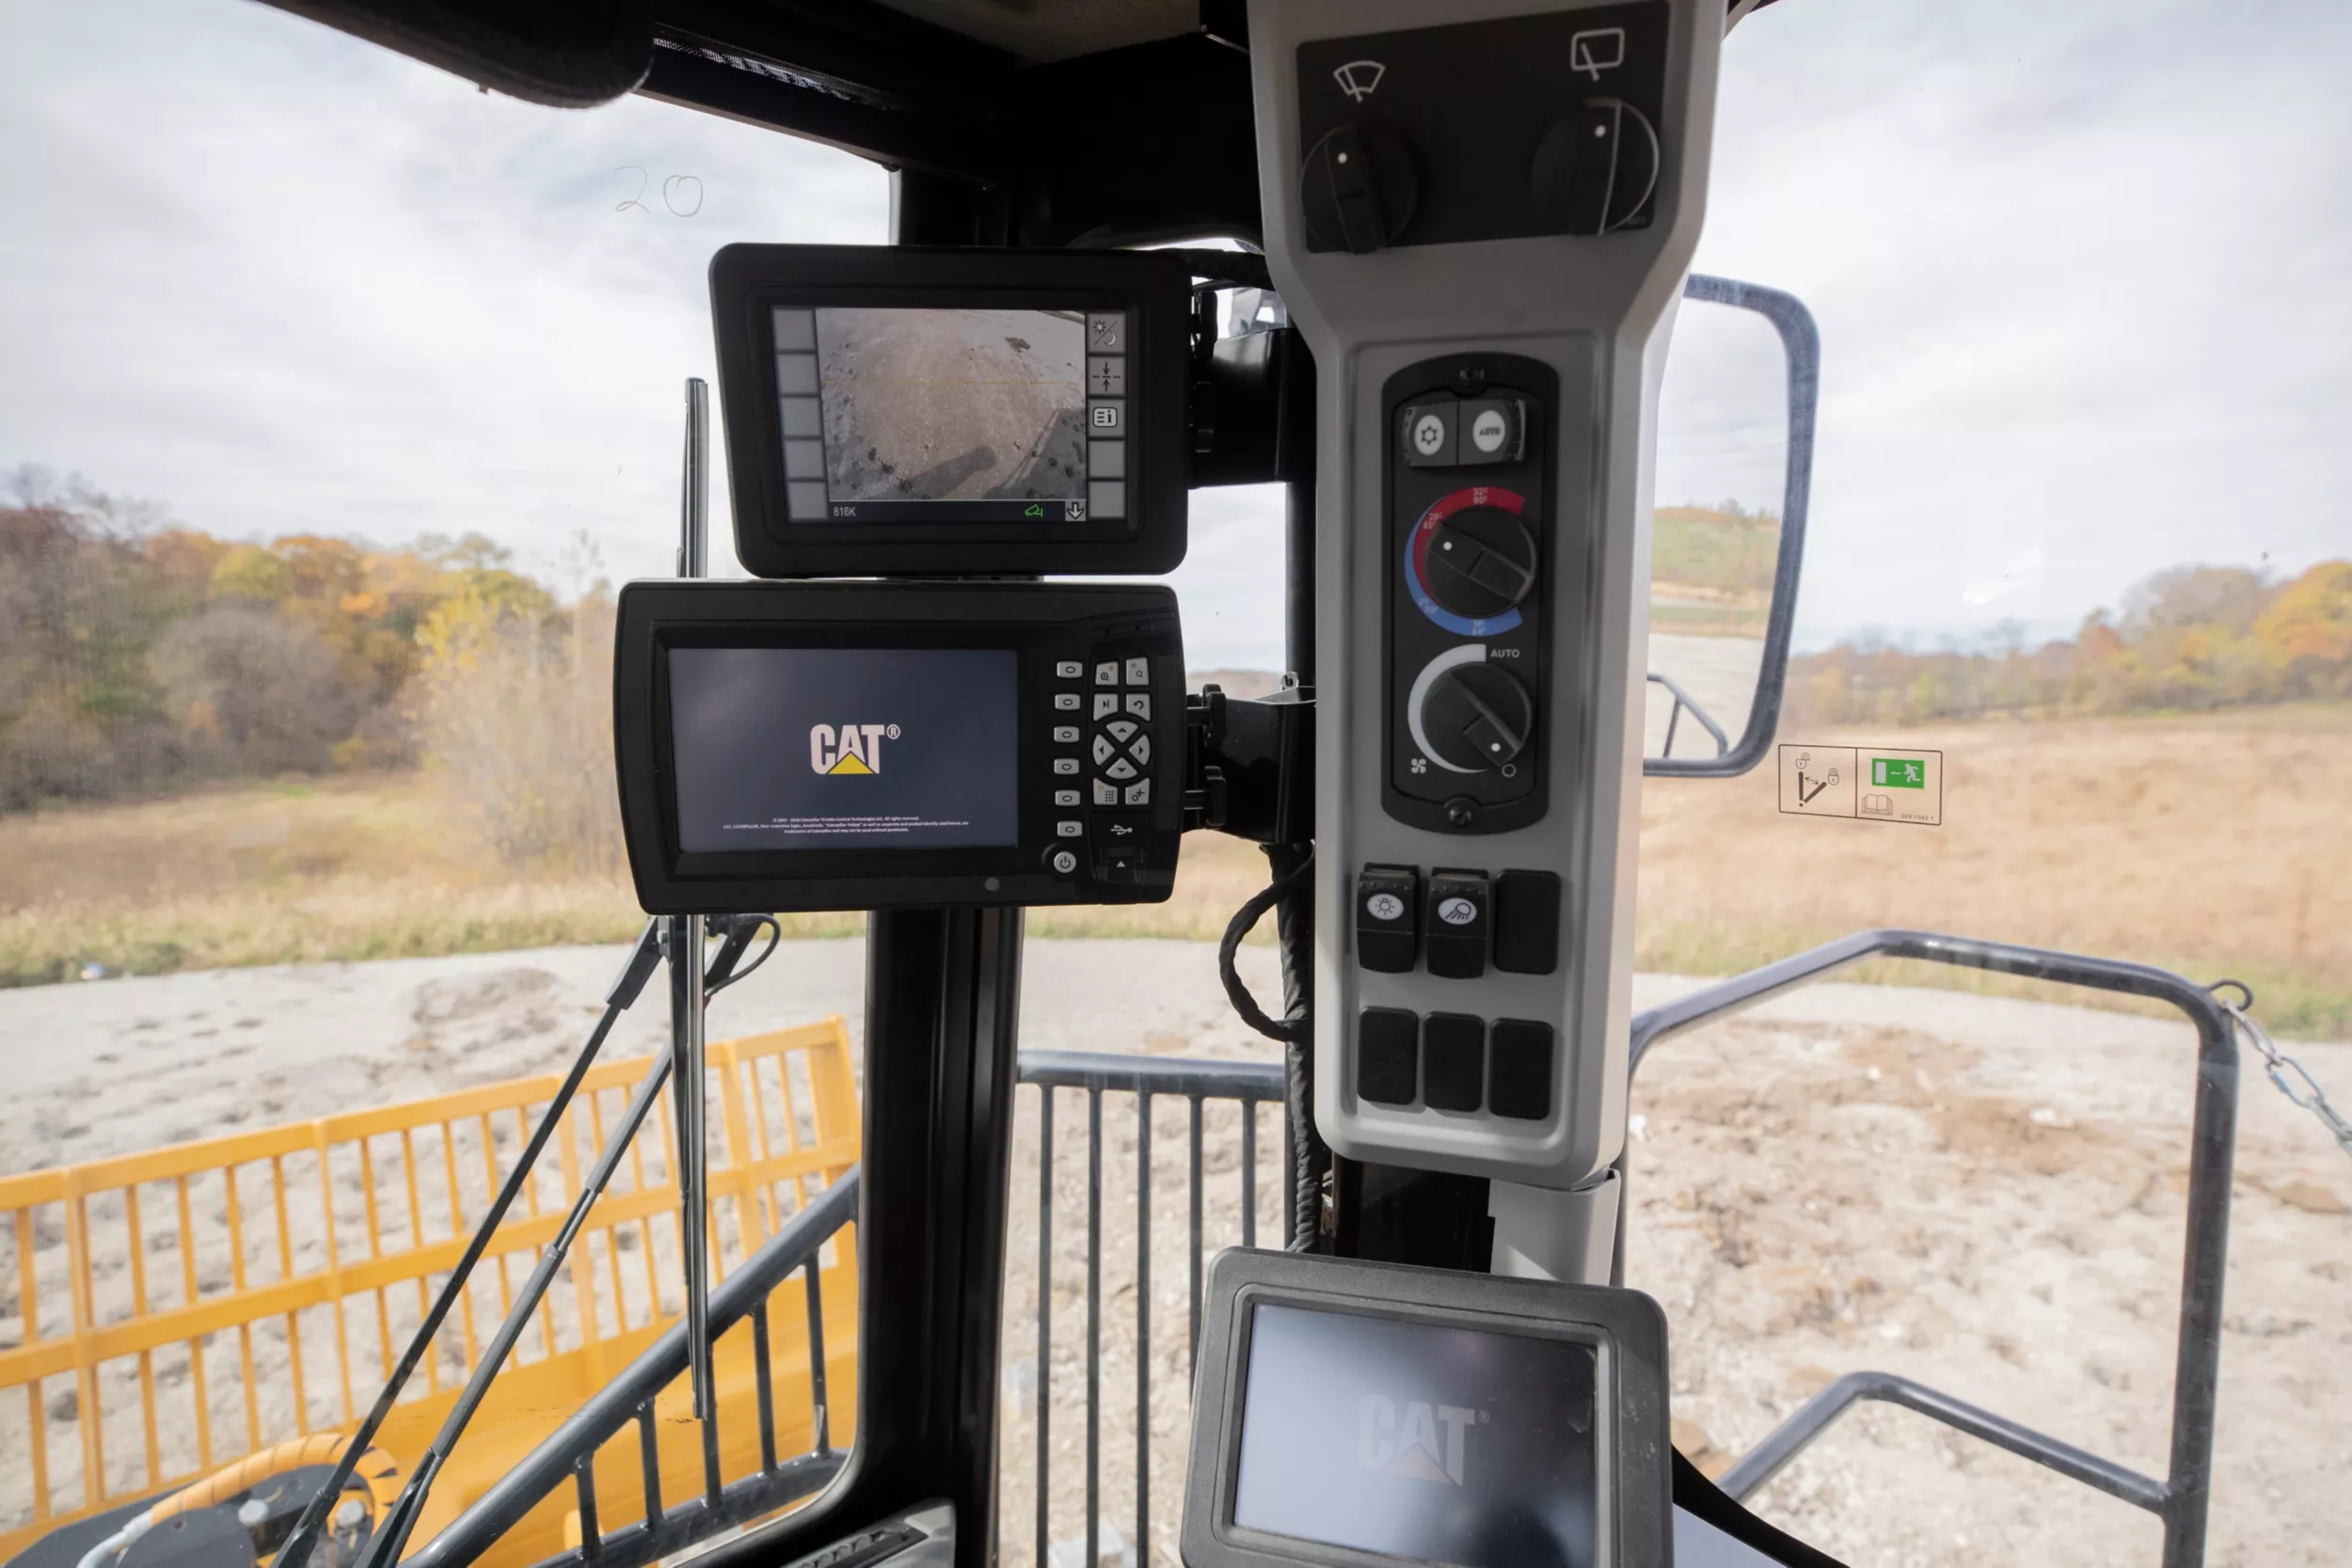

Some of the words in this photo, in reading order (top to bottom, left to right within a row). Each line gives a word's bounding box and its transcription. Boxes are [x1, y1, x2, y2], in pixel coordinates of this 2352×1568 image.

[613, 166, 703, 217] 20
[1479, 427, 1501, 436] AUTO
[834, 506, 856, 516] 816K
[1490, 649, 1520, 658] AUTO
[1131, 788, 1145, 802] OK
